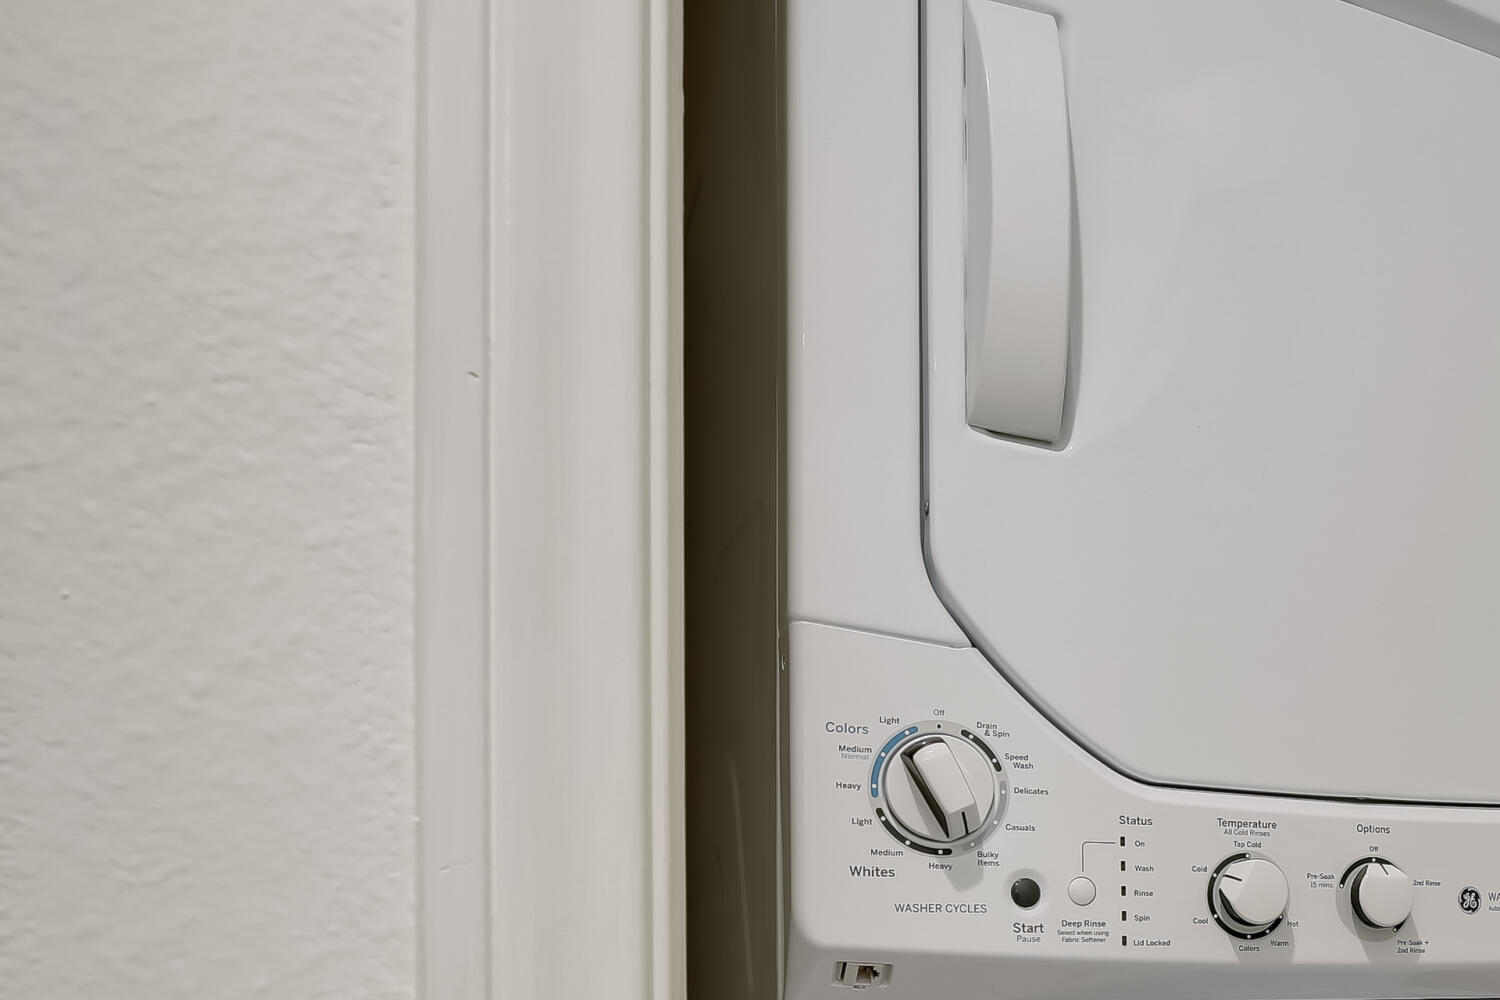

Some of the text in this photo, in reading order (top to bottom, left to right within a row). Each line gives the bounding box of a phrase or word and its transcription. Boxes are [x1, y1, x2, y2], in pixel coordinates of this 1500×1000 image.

[879, 716, 900, 724] Light
[826, 722, 869, 734] Colors
[977, 722, 997, 730] Drain
[992, 730, 1009, 738] Spin
[839, 745, 872, 753] Medium
[1005, 753, 1028, 762] Speed
[836, 782, 861, 790] Heavy
[852, 818, 872, 826] Light
[1119, 816, 1152, 825] Status
[1217, 818, 1277, 829] Temperature
[1006, 824, 1035, 832] Casuals
[1357, 824, 1390, 835] Options
[978, 851, 999, 859] Bulky
[928, 862, 952, 871] Heavy
[978, 859, 999, 867] Items
[850, 866, 895, 878] Whites
[894, 904, 987, 914] WASHER CYCLES
[1013, 922, 1044, 933] Start
[1062, 920, 1082, 928] Deep
